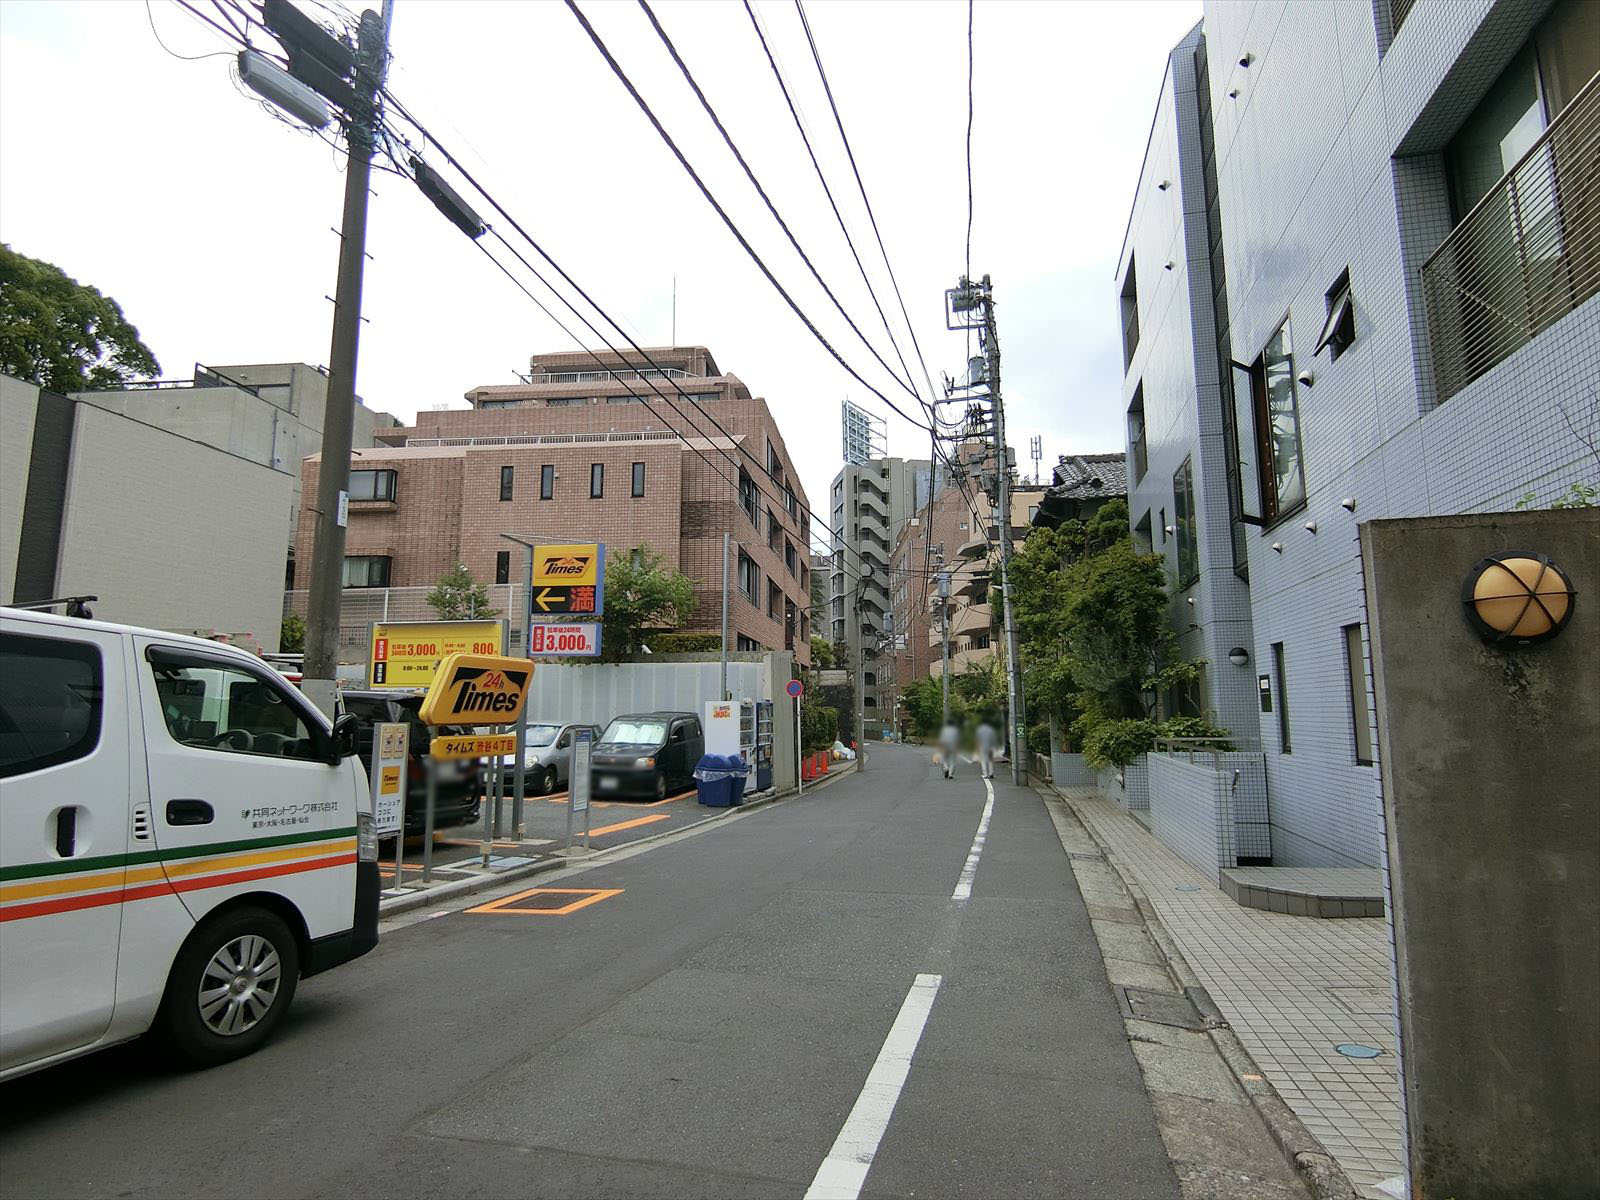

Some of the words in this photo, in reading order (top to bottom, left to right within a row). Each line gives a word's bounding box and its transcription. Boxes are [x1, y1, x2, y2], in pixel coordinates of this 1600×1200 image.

[544, 562, 584, 576] Times
[569, 587, 595, 612] 満
[483, 672, 505, 689] 24h
[452, 681, 520, 713] Times
[446, 742, 475, 753] タイムズ
[476, 740, 513, 753] 渋谷4丁目
[252, 801, 338, 818] 共同ネットワーク株式会社
